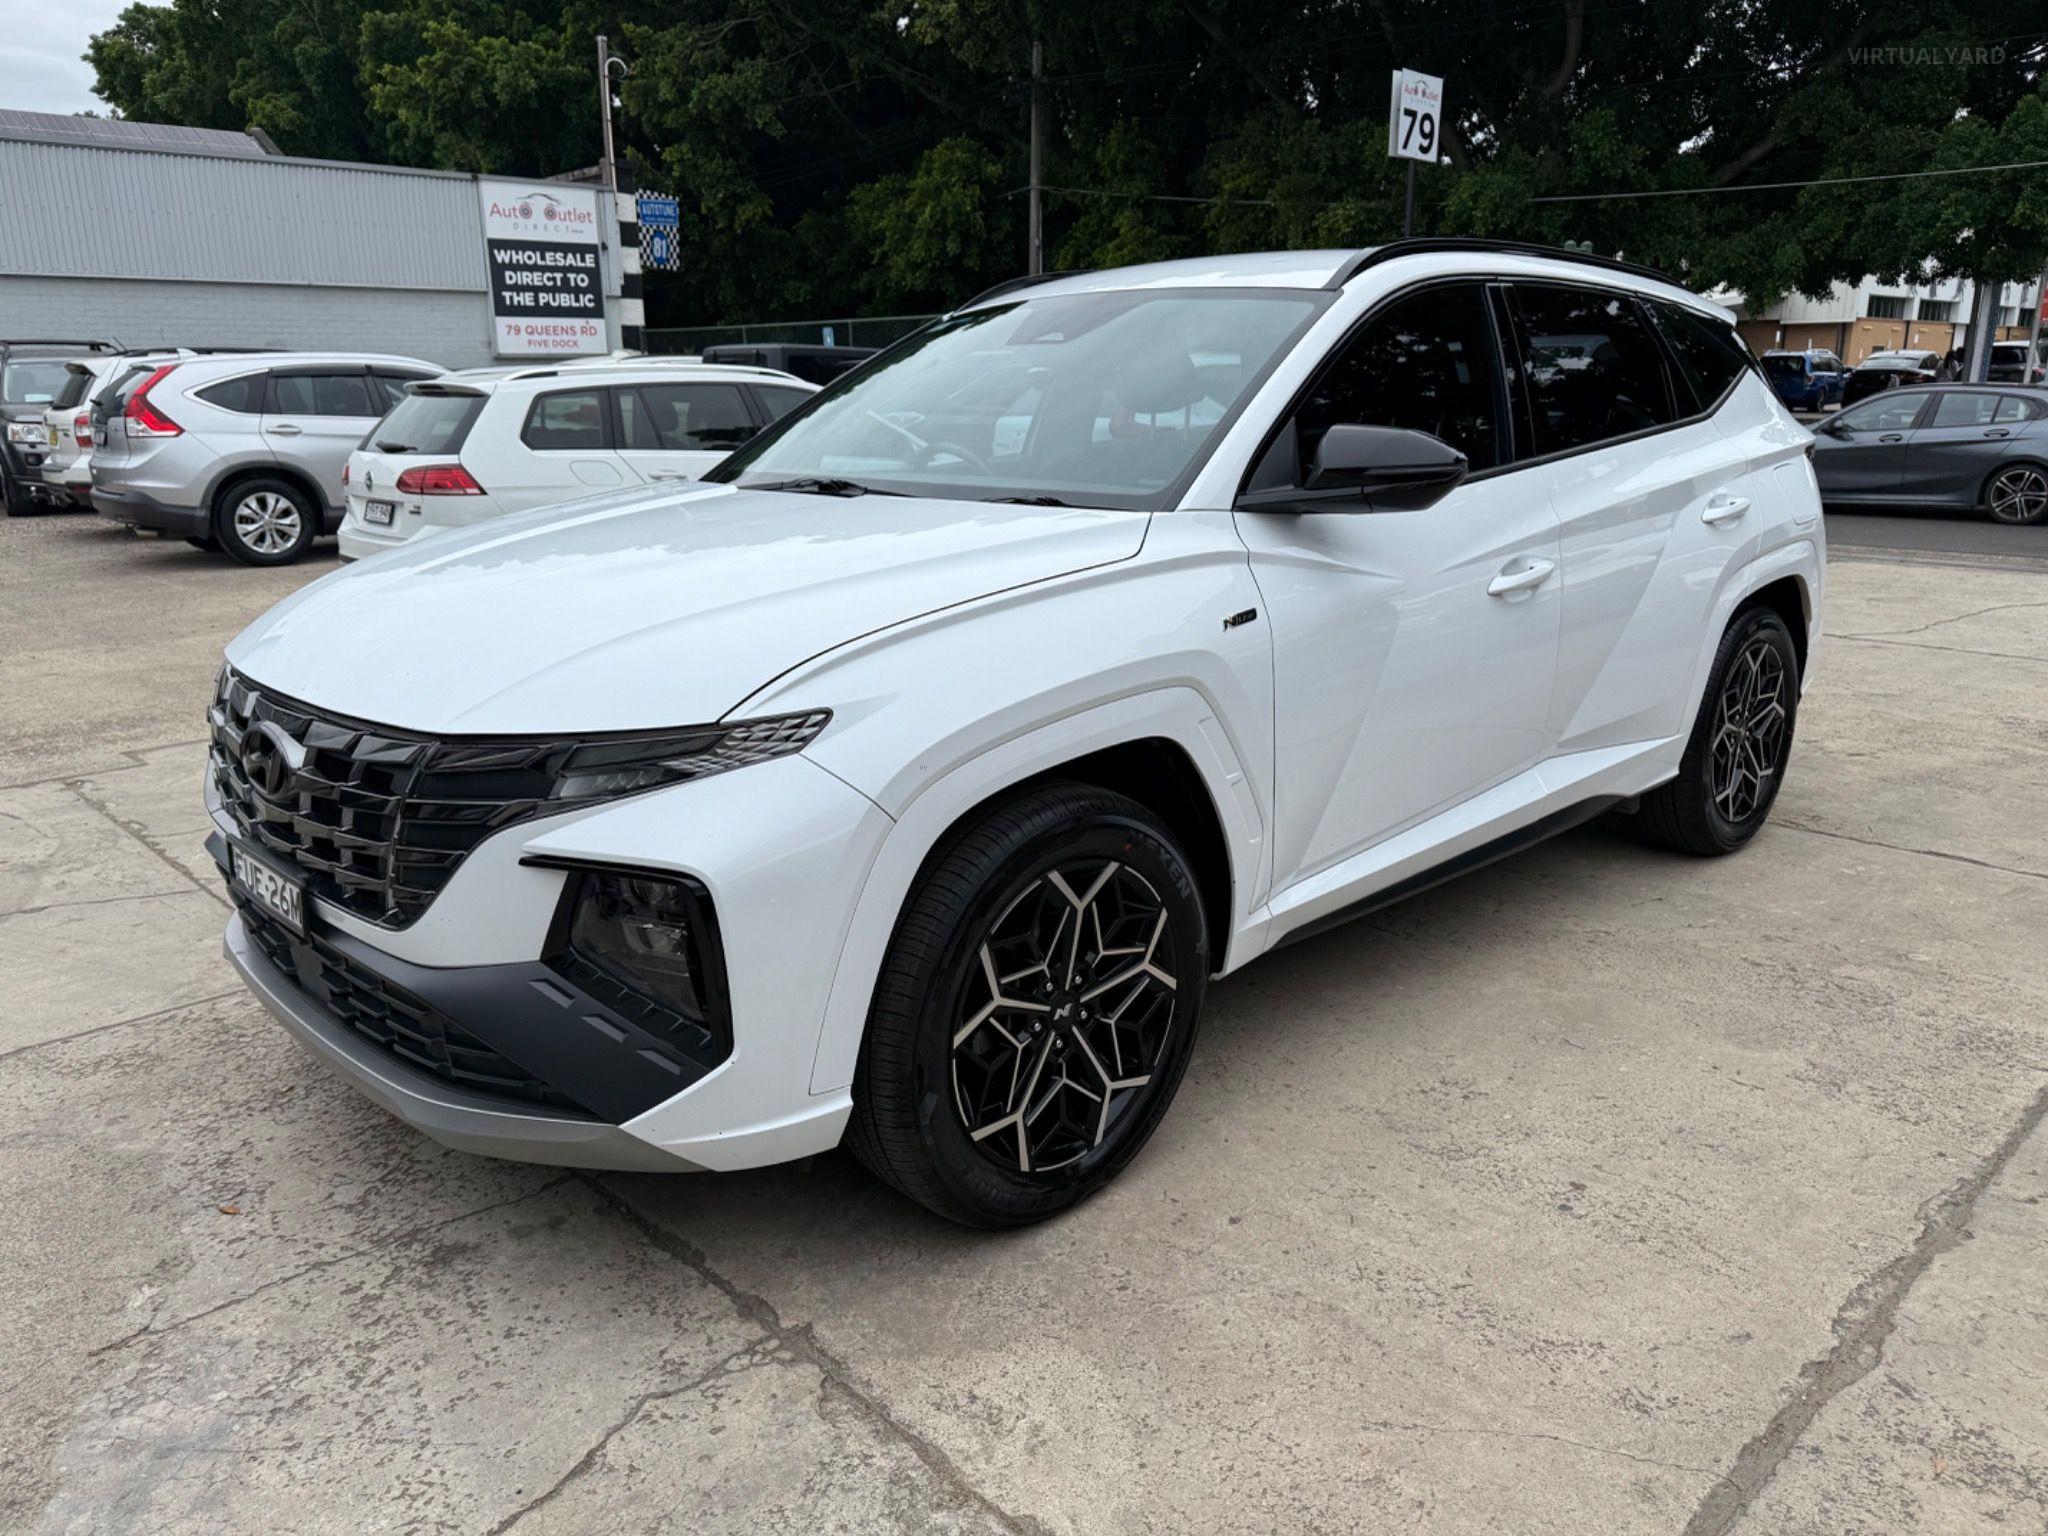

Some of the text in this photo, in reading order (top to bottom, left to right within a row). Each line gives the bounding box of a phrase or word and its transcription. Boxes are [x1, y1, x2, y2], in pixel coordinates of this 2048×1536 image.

[1402, 107, 1435, 155] 79
[489, 201, 593, 224] Auto Outlet
[512, 222, 570, 234] DIRECT
[653, 236, 667, 259] 81
[493, 249, 596, 268] WHOLESALE
[504, 270, 589, 288] DIRECT TO
[501, 291, 595, 308] THE PUBLIC
[505, 324, 598, 336] 79 QUEENS RD
[527, 339, 580, 348] FIVE DOCK
